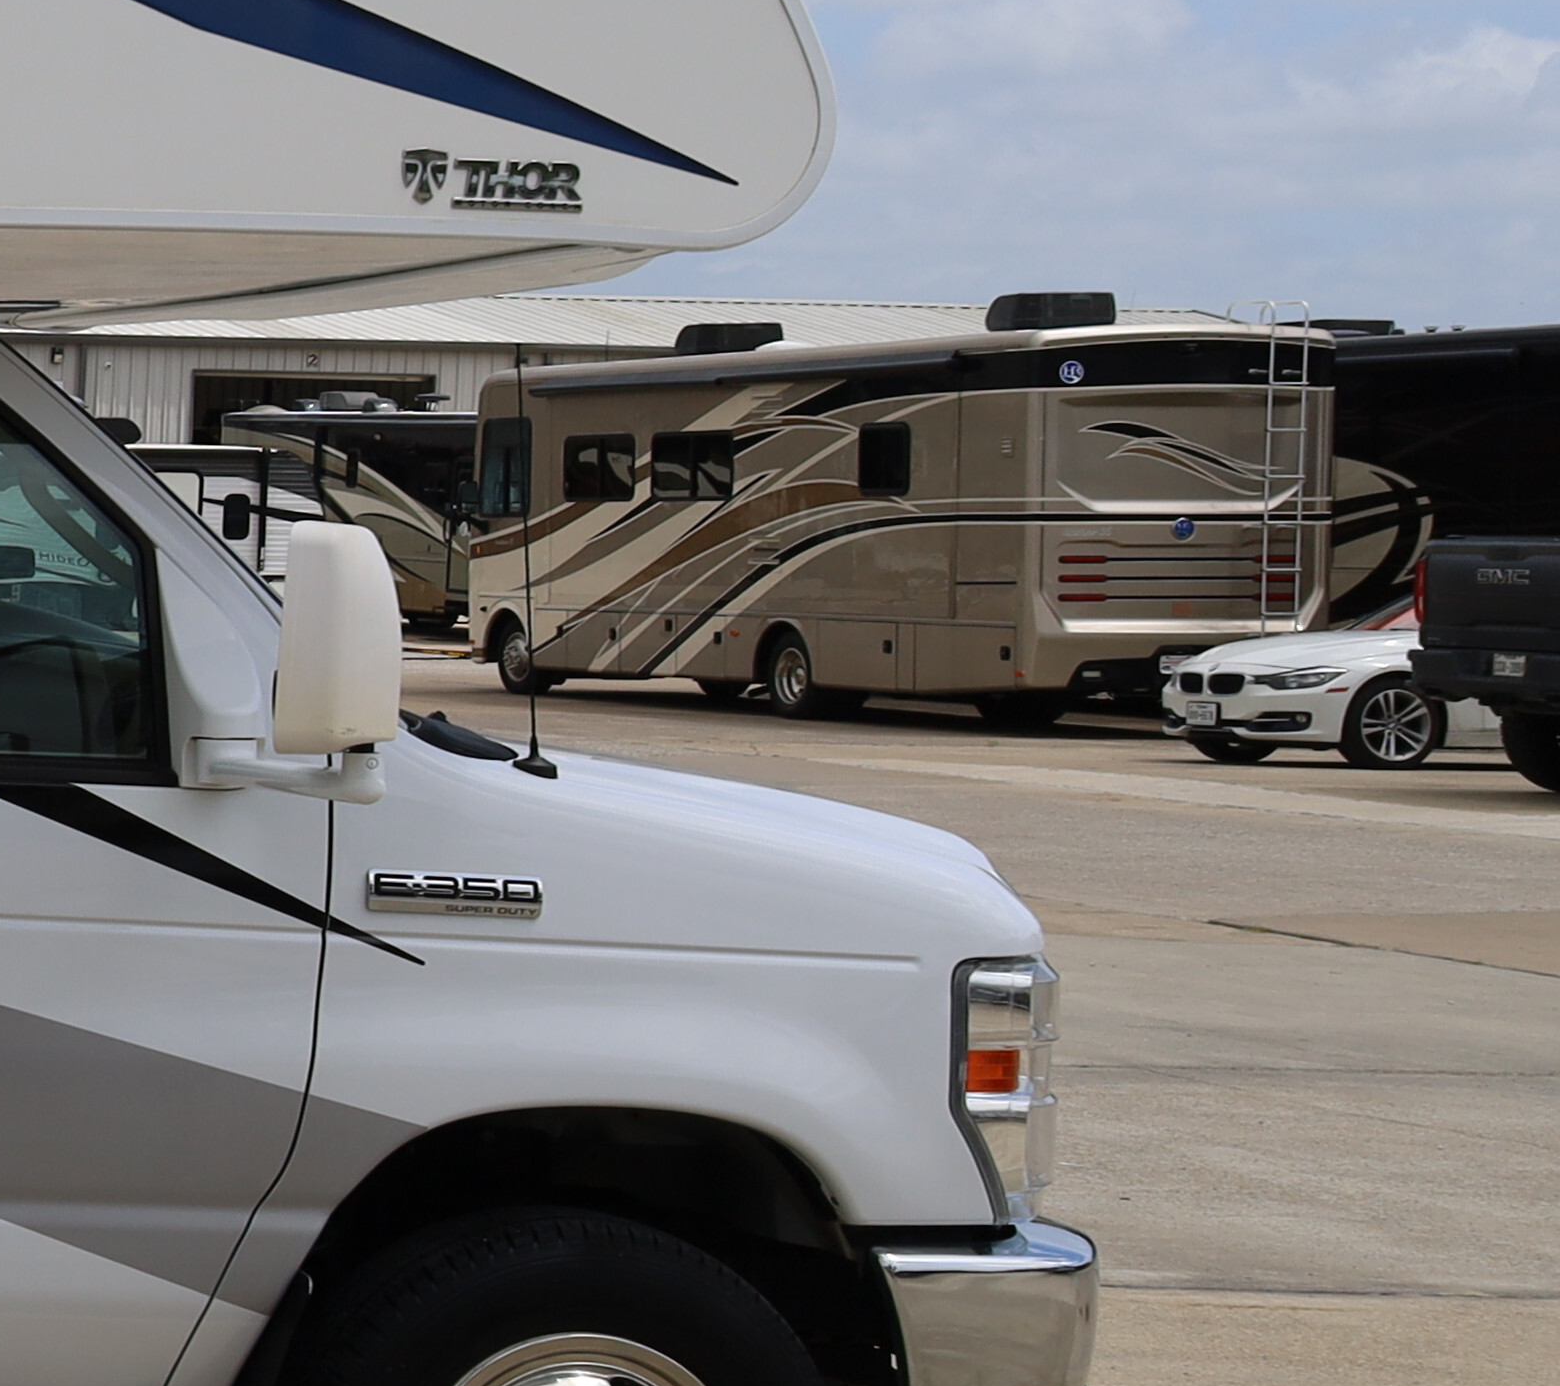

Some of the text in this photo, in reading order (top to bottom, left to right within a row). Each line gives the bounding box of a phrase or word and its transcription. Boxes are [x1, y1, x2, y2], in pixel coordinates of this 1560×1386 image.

[453, 158, 582, 200] THOR
[305, 353, 319, 368] 2
[39, 551, 91, 567] HIDEO
[1477, 568, 1530, 585] GMC
[445, 904, 537, 916] SUPER DUTY
